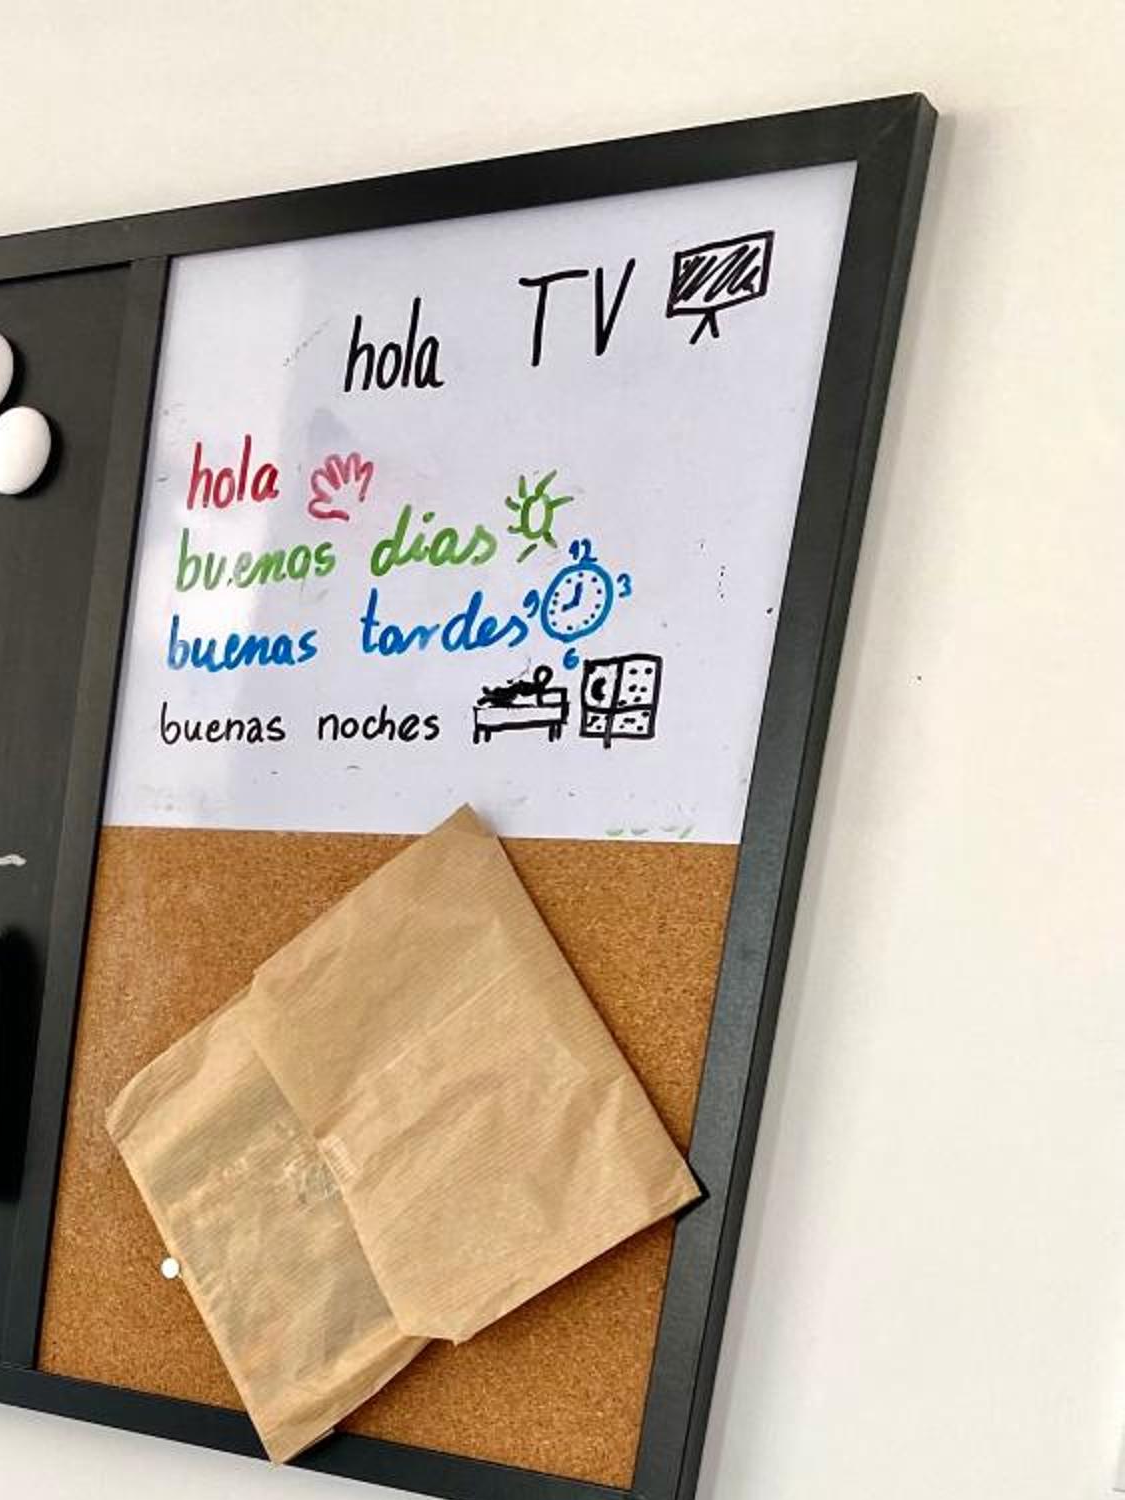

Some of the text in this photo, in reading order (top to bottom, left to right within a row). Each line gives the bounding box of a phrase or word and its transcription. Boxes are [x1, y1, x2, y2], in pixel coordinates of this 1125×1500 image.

[344, 297, 443, 392] hola
[519, 258, 635, 367] TV
[186, 435, 279, 510] hola
[167, 588, 529, 673] buenas tardes
[160, 702, 440, 745] buenas noches
